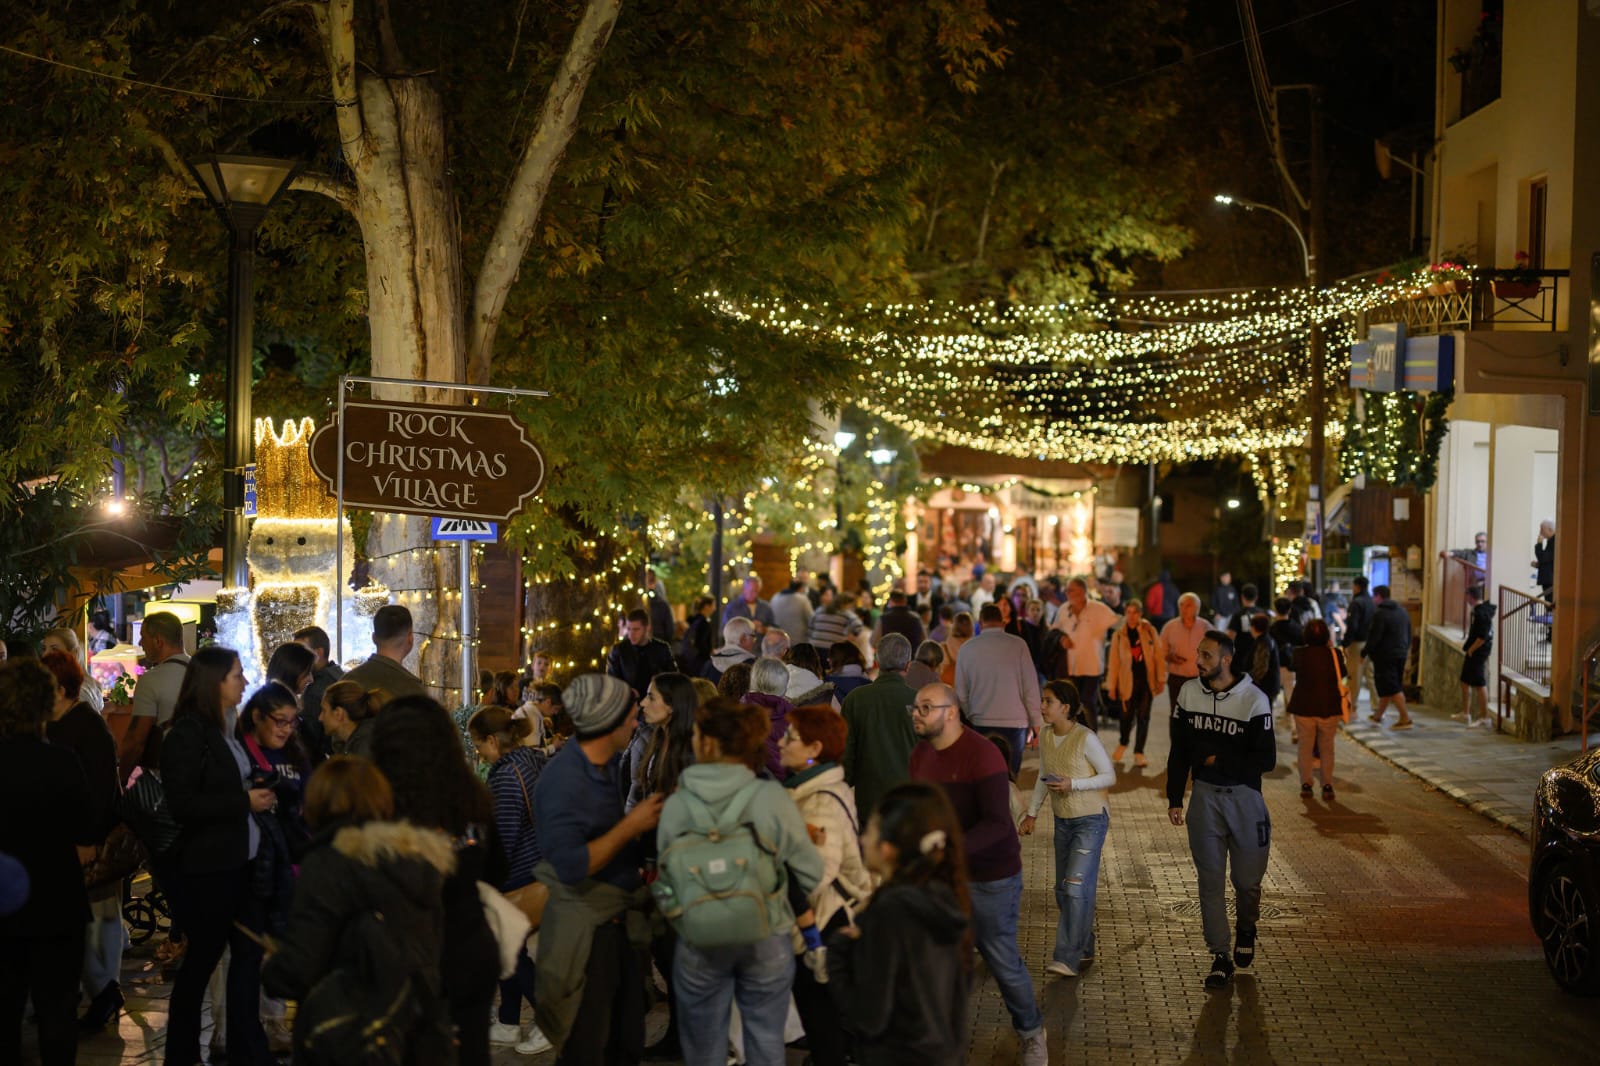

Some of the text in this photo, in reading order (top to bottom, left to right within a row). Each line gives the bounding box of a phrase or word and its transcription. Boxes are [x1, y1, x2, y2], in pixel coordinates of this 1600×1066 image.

[388, 411, 474, 444] ROCK
[346, 440, 507, 479] CHRISTMAS
[372, 471, 478, 509] VILLAGE
